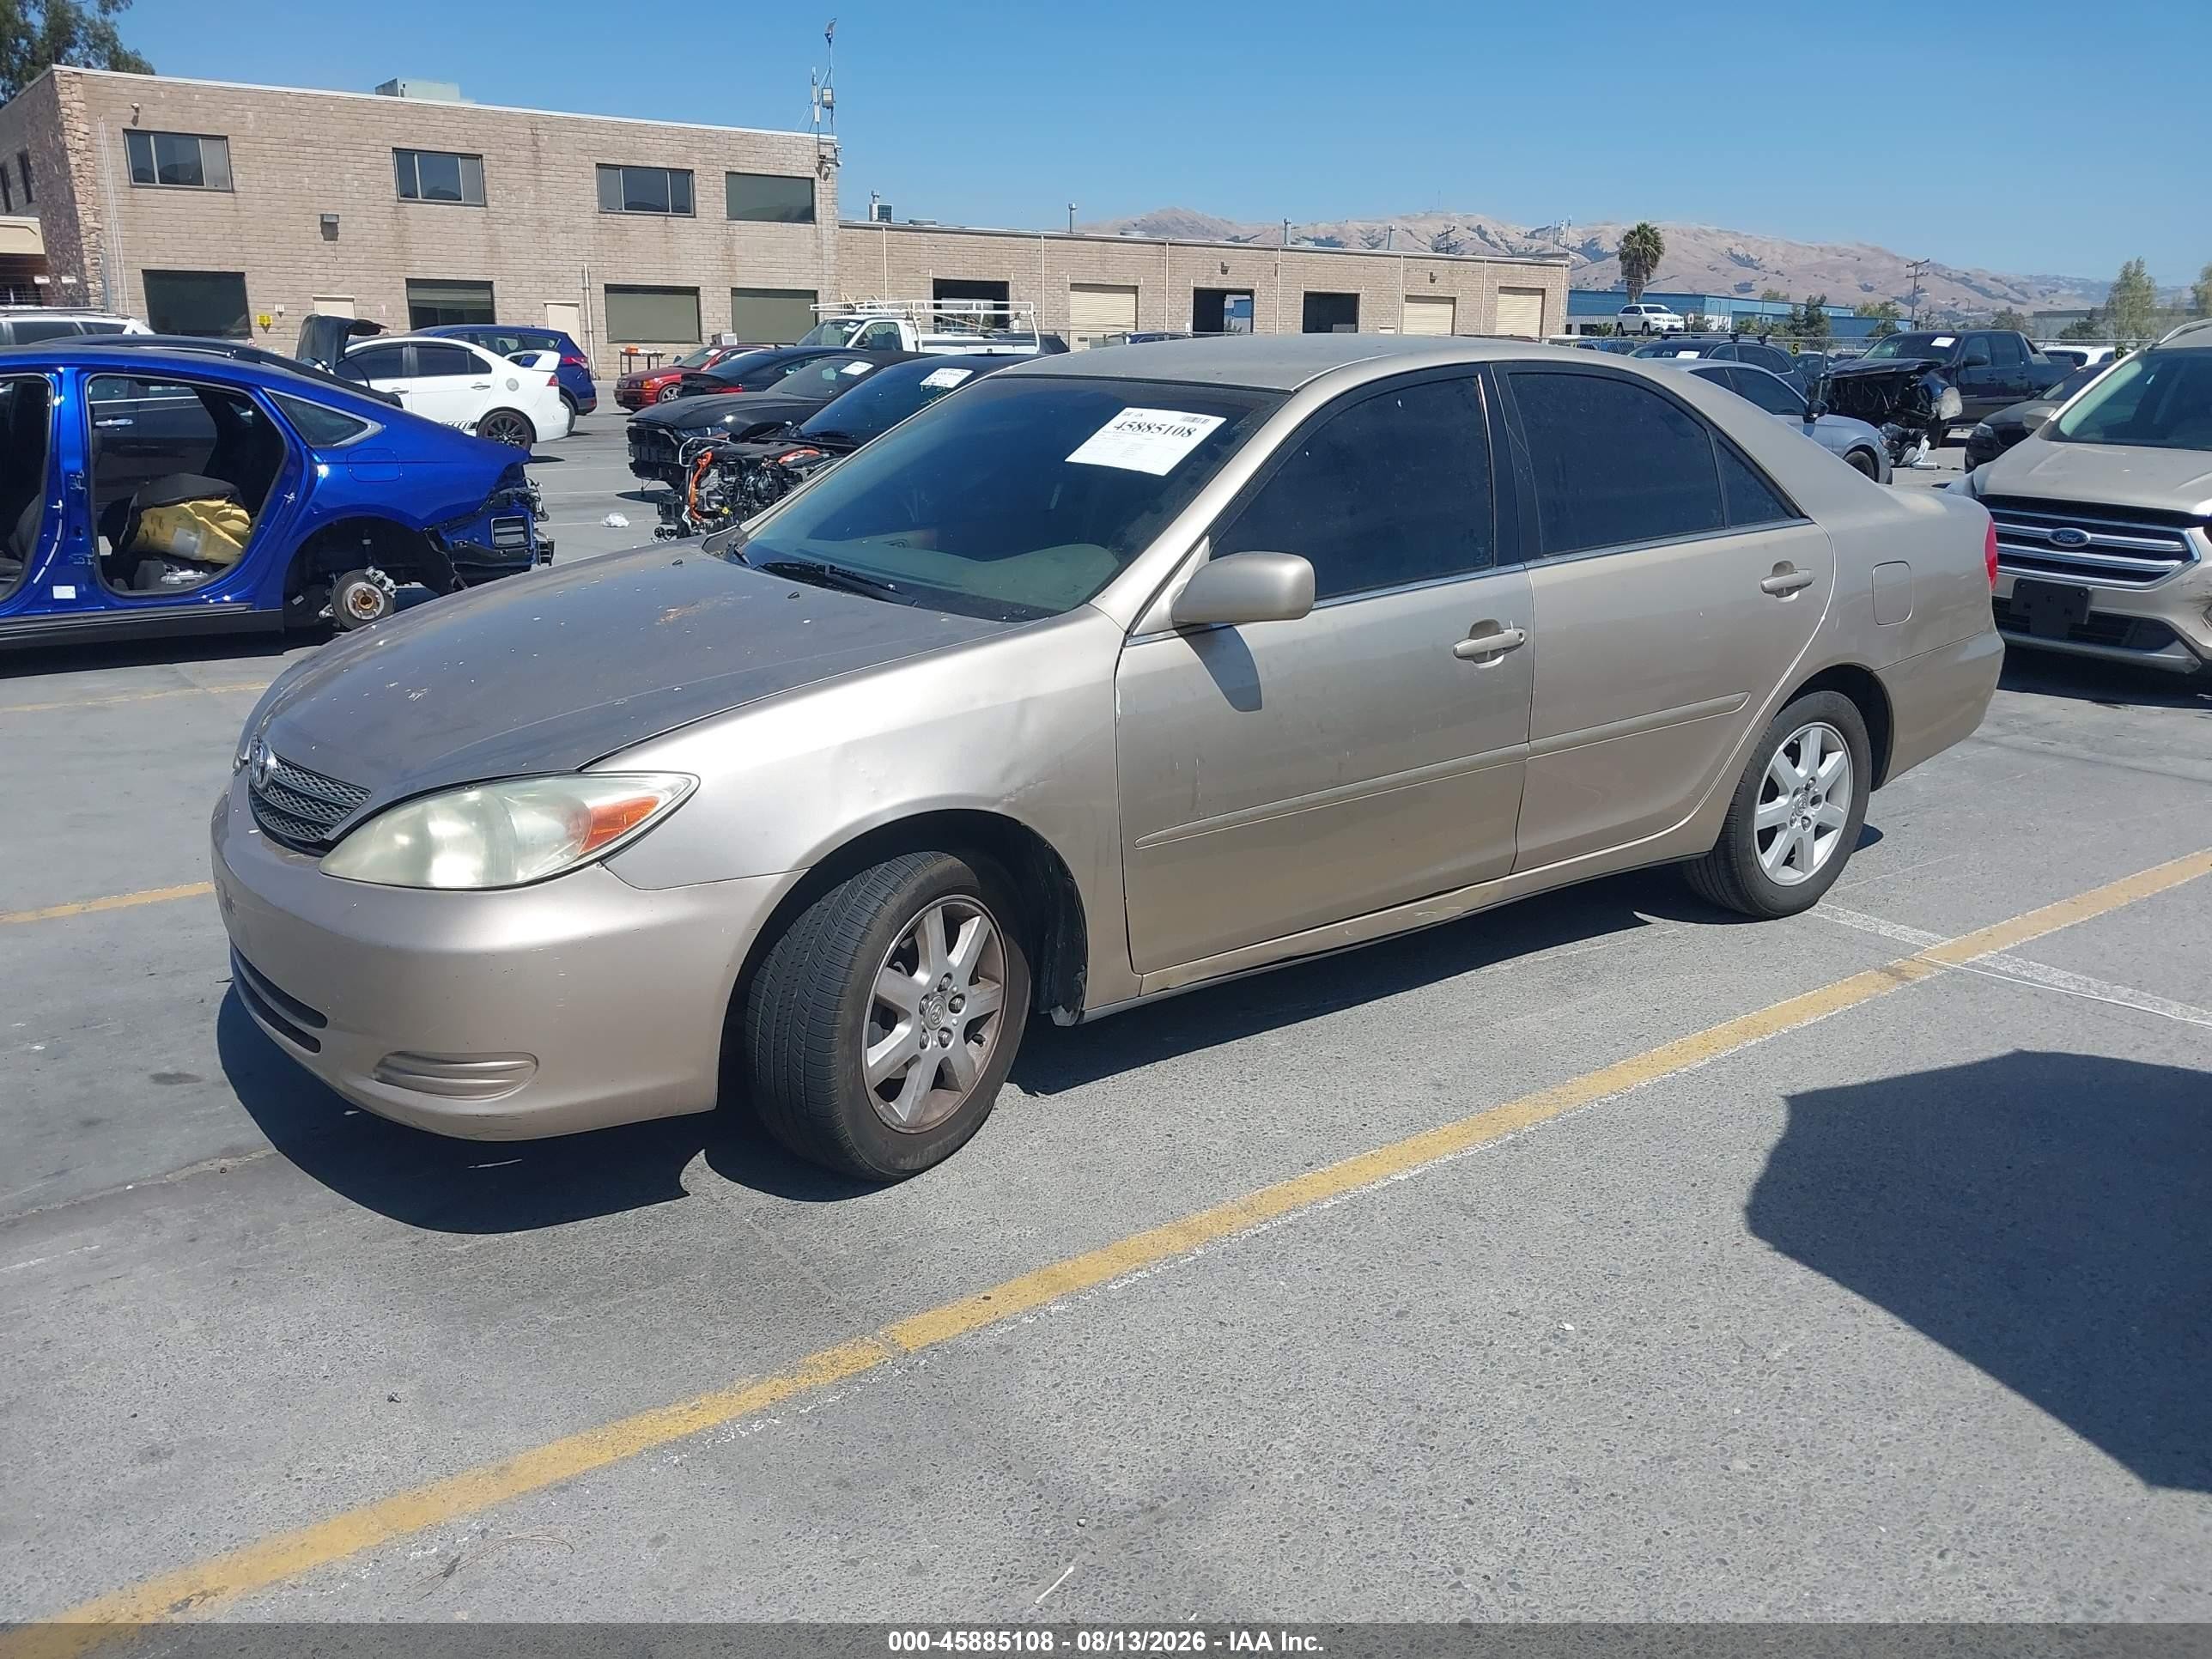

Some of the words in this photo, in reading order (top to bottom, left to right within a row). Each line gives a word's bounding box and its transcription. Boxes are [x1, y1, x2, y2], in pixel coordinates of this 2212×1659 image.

[1791, 343, 1799, 355] 5
[2115, 346, 2124, 360] 6
[1113, 420, 1197, 438] 45885108
